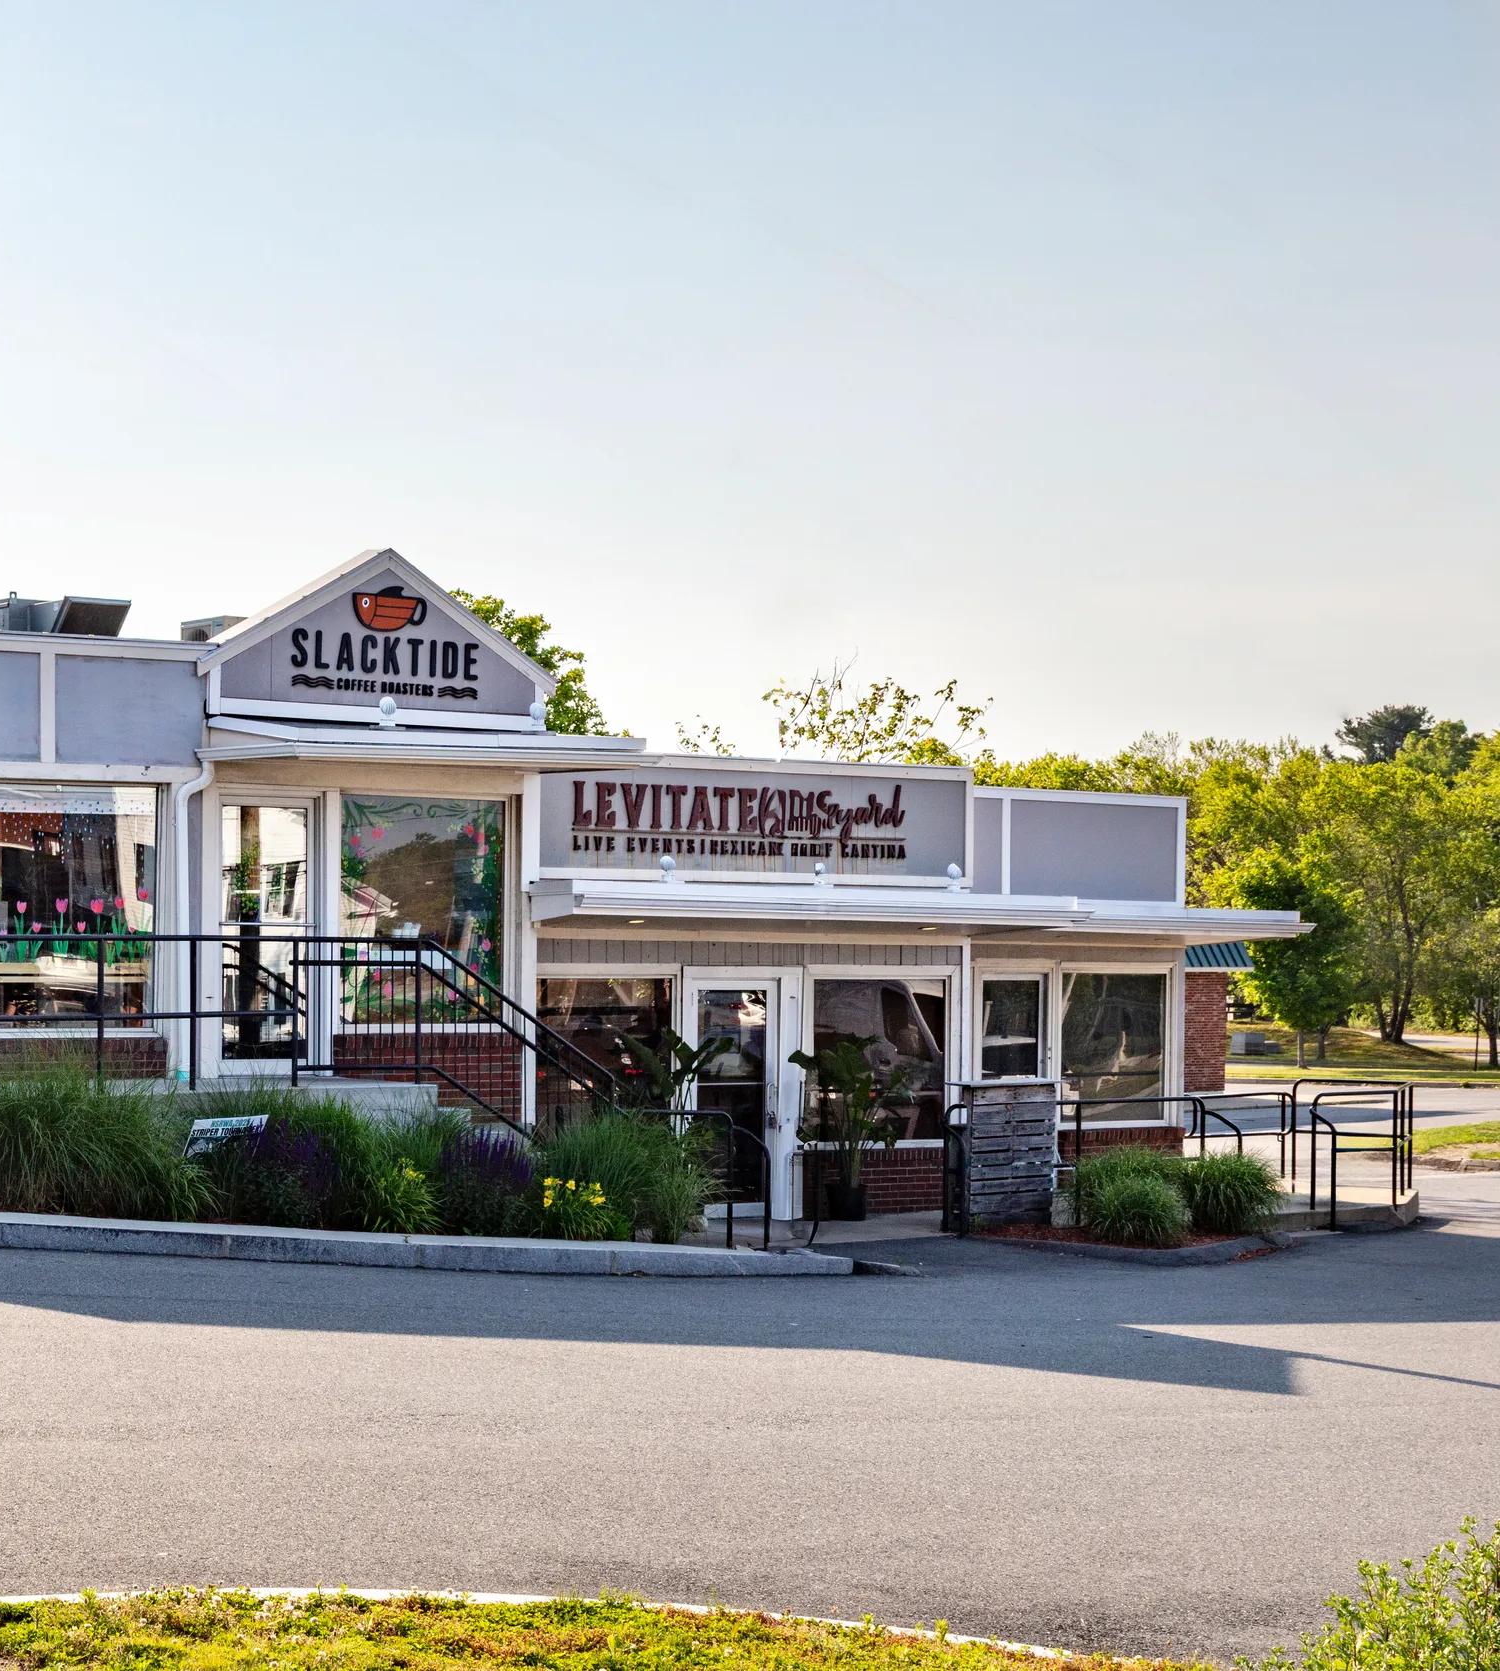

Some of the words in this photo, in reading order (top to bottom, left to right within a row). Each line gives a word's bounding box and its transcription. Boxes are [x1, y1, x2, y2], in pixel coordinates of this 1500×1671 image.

[291, 627, 480, 681] SLACKTIDE
[336, 677, 377, 693] COFFEE
[380, 681, 434, 697] ROASTERS
[572, 780, 758, 832] LEVITATE
[572, 835, 615, 851] LIVE
[626, 837, 696, 855] EVENTS
[191, 1127, 219, 1137] STRIPER
